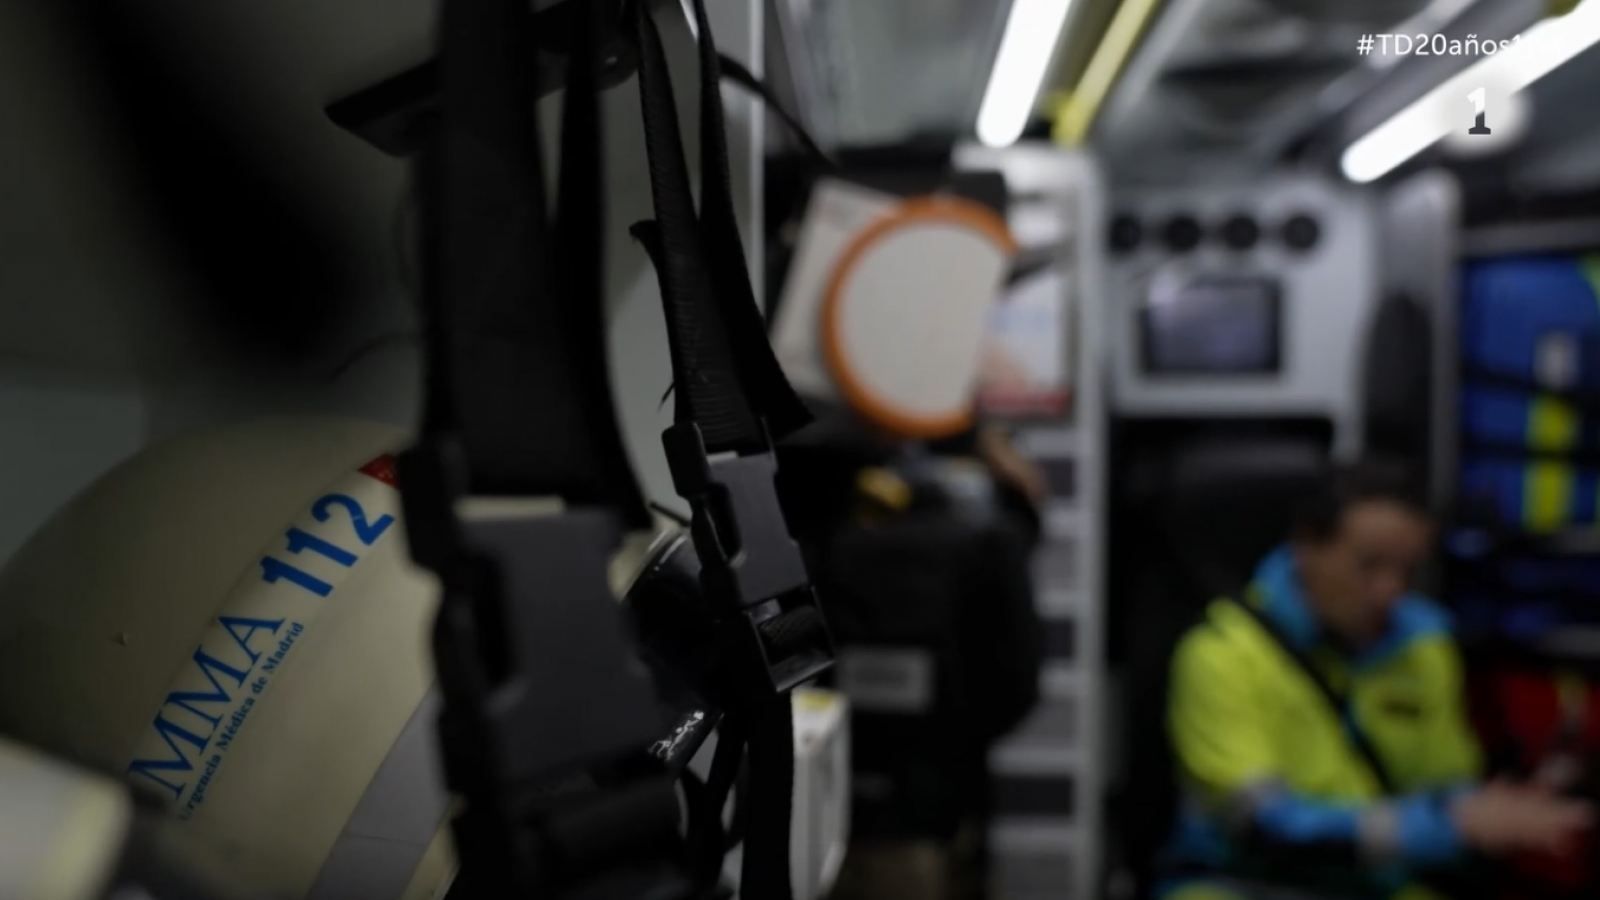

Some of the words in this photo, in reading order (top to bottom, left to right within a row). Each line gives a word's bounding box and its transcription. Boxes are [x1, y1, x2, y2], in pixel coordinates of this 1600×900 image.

[259, 493, 395, 597] 112
[215, 696, 255, 752] Médica
[251, 676, 268, 695] de
[262, 621, 305, 674] Madrid
